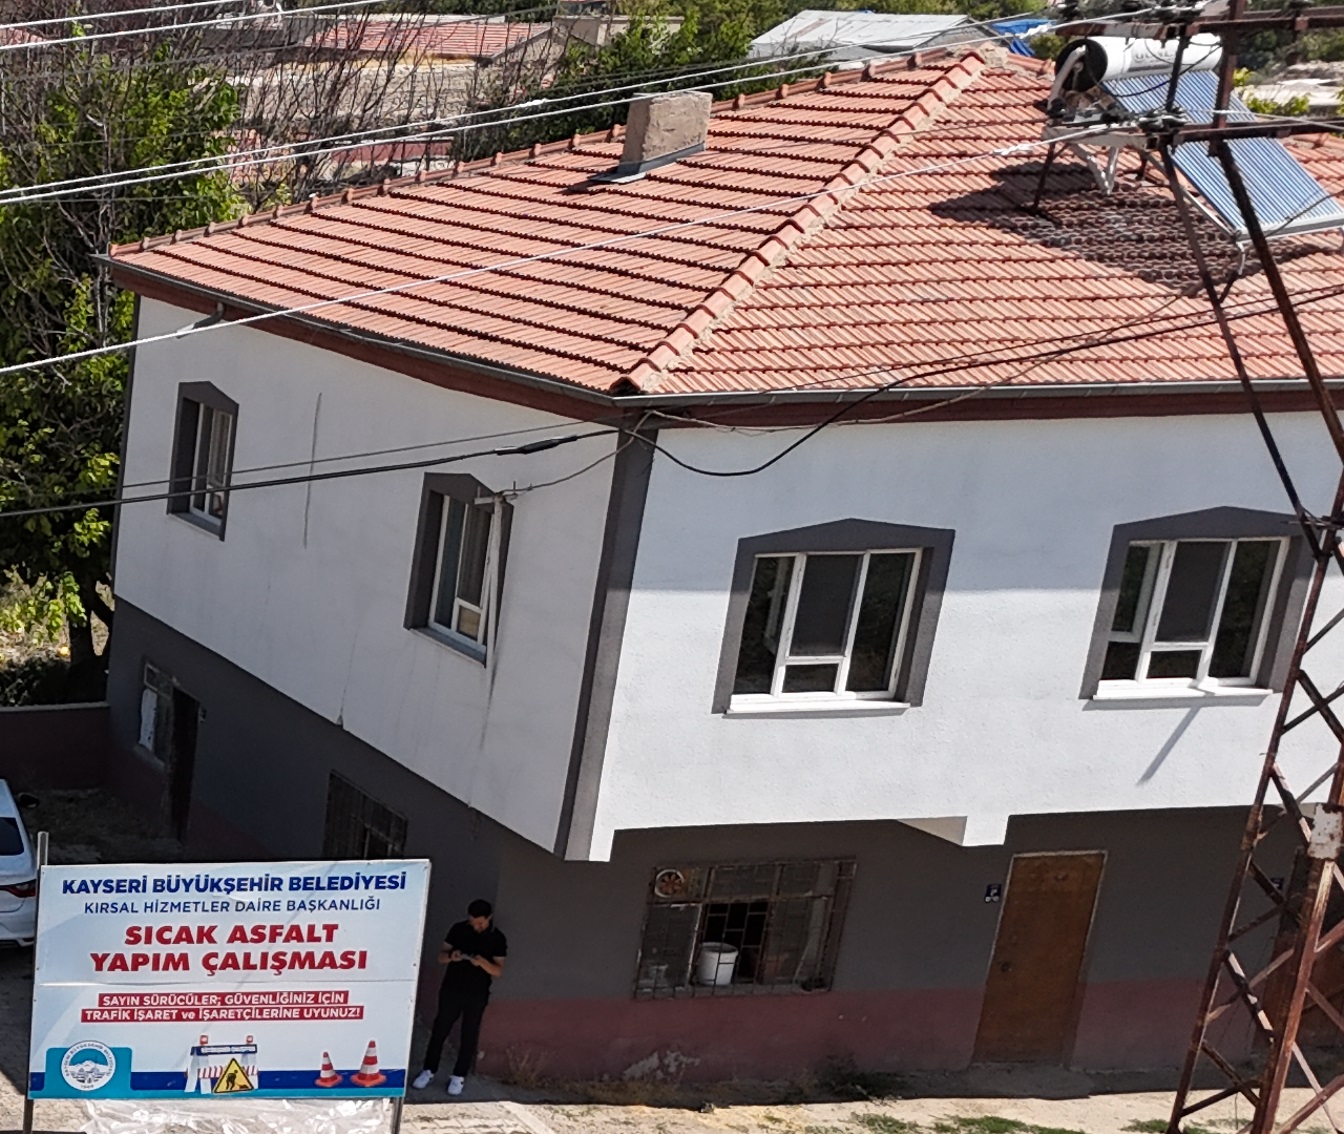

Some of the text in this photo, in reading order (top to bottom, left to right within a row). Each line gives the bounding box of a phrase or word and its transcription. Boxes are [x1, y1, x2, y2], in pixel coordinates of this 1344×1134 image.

[62, 871, 407, 895] KAYSERİ BÜYÜKŞEHİR BELEDİYESİ
[84, 895, 380, 913] KIRSAL HİZMETLER DAİRE BAŞKANLIĞI
[124, 924, 339, 945] SICAK ASFALT
[90, 950, 368, 976] YAPIM ÇALIŞMASI
[103, 996, 140, 1006] SAYIN
[224, 991, 315, 1005] GÜVENLİĞİNİZ
[318, 990, 345, 1005] İÇİN
[85, 1007, 361, 1021] TRAFİK İŞARET ve İŞARETÇİLERİNE UYUNUZ!
